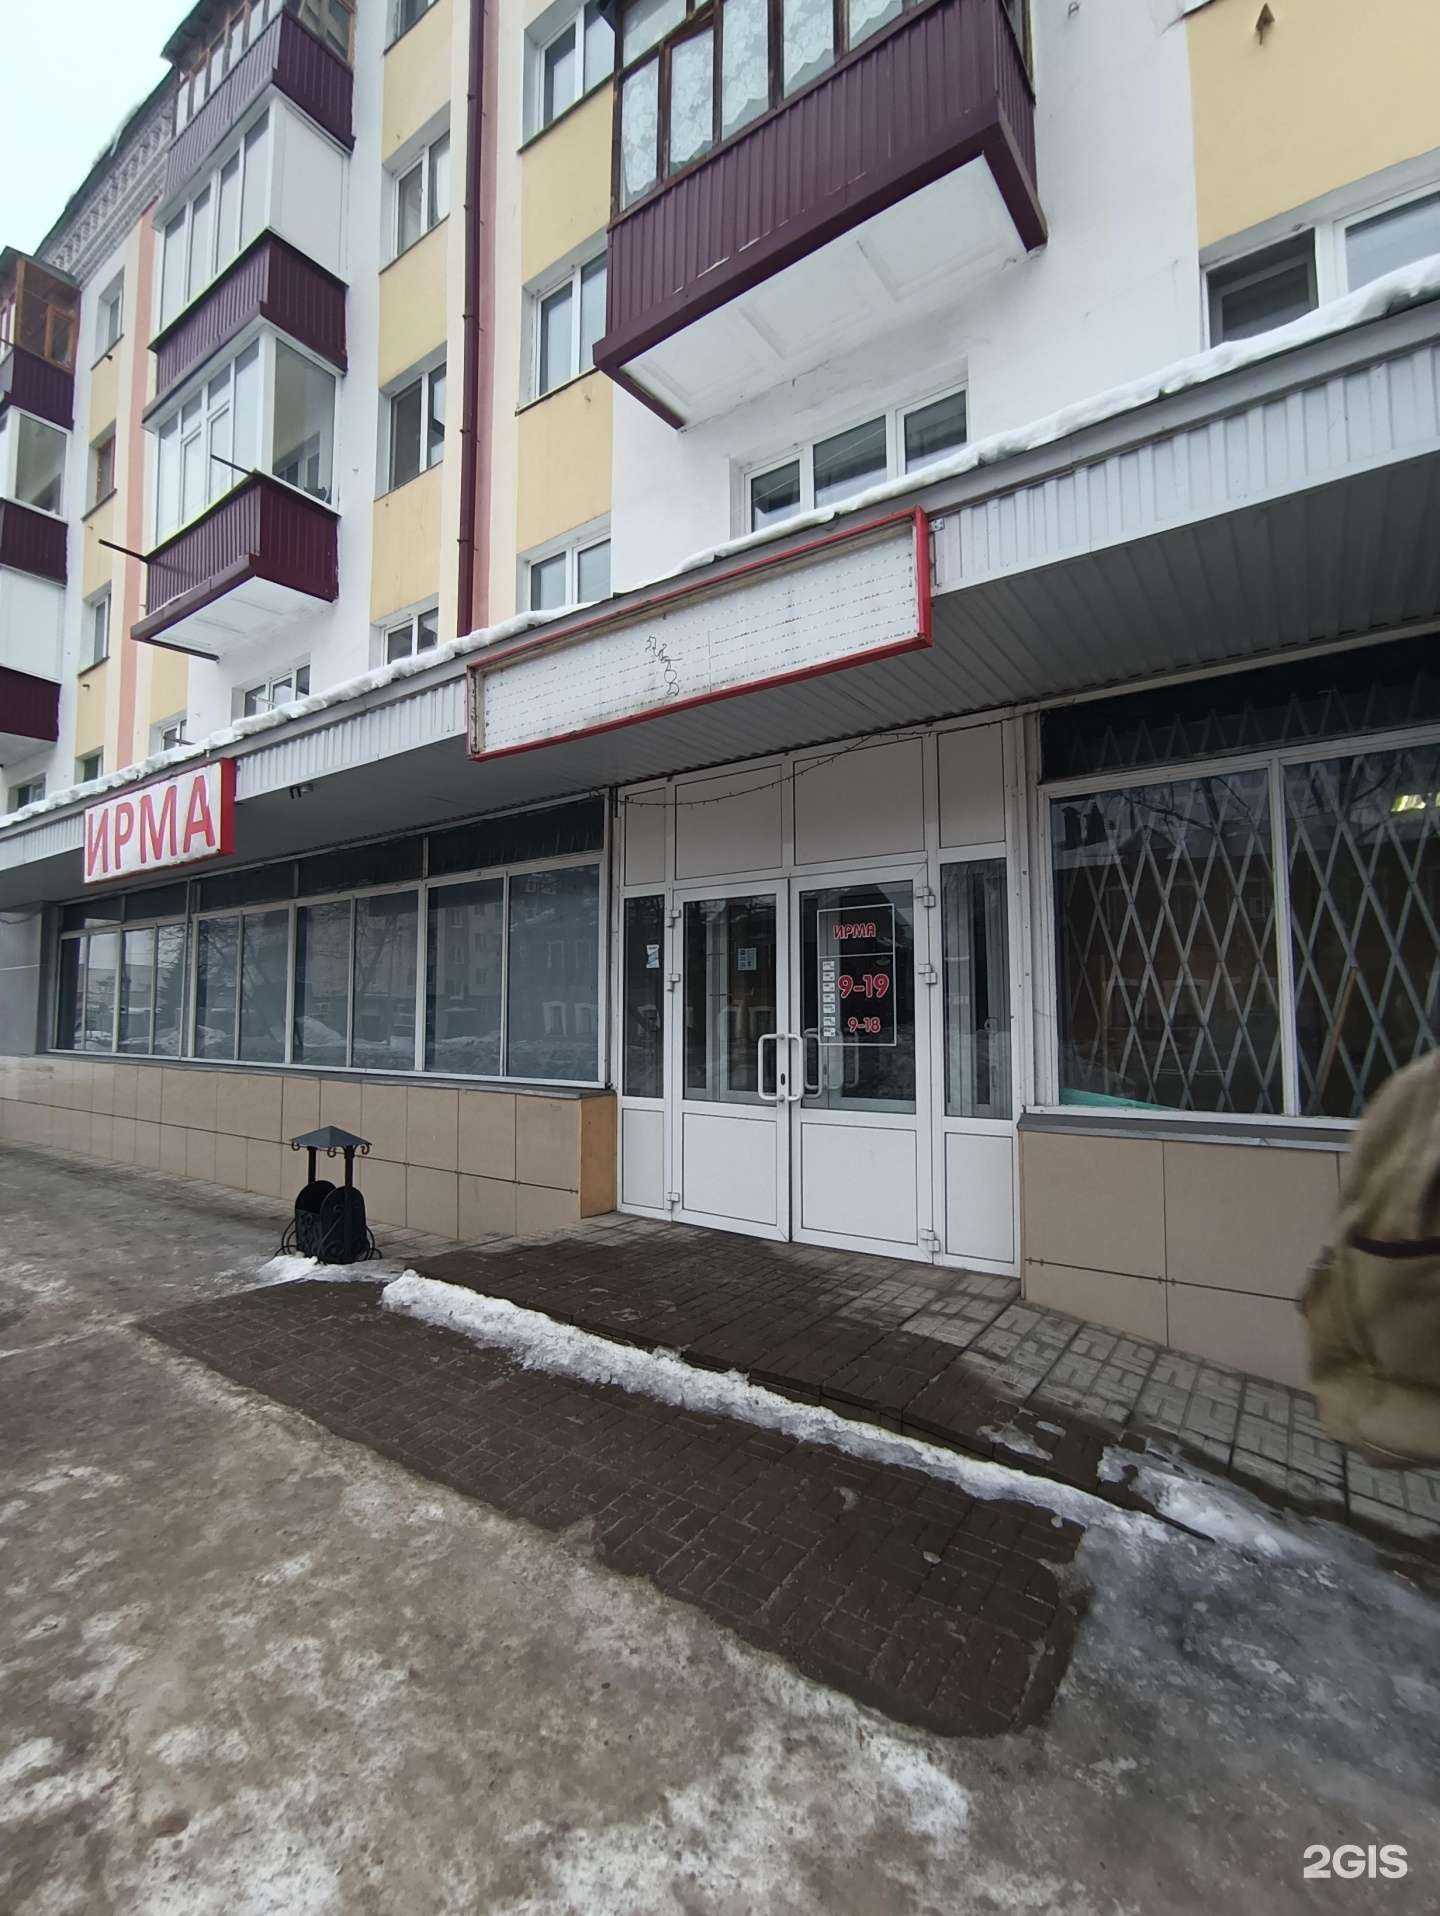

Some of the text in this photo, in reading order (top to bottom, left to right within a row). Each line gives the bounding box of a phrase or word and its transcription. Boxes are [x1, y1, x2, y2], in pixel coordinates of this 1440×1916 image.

[86, 774, 216, 877] ИРМА
[833, 922, 876, 939] ИРМА
[837, 973, 890, 998] 9-19
[847, 1016, 881, 1033] 9-18
